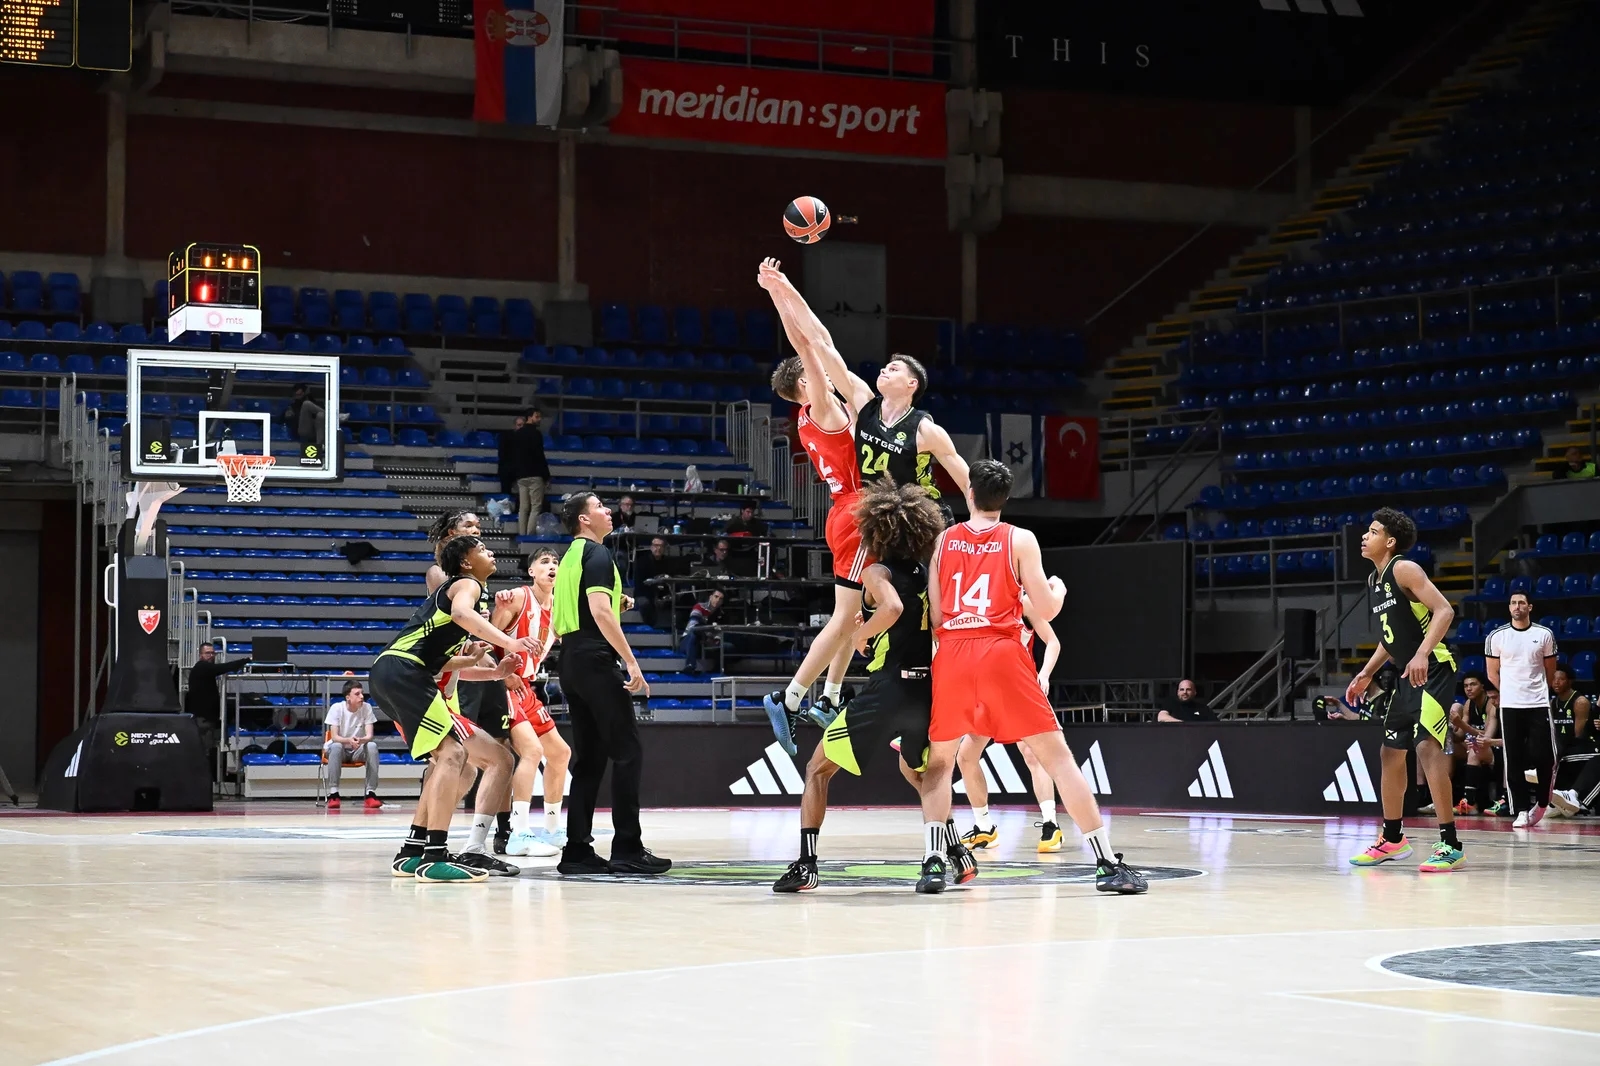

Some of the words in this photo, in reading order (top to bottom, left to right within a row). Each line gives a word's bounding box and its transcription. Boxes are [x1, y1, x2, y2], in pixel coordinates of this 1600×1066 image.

[1005, 34, 1150, 68] THIS
[225, 316, 244, 325] mts
[860, 429, 903, 455] NEXTGEN
[861, 443, 890, 475] 24
[948, 539, 975, 555] CRVENA
[951, 571, 992, 616] 14
[1380, 612, 1395, 645] 3
